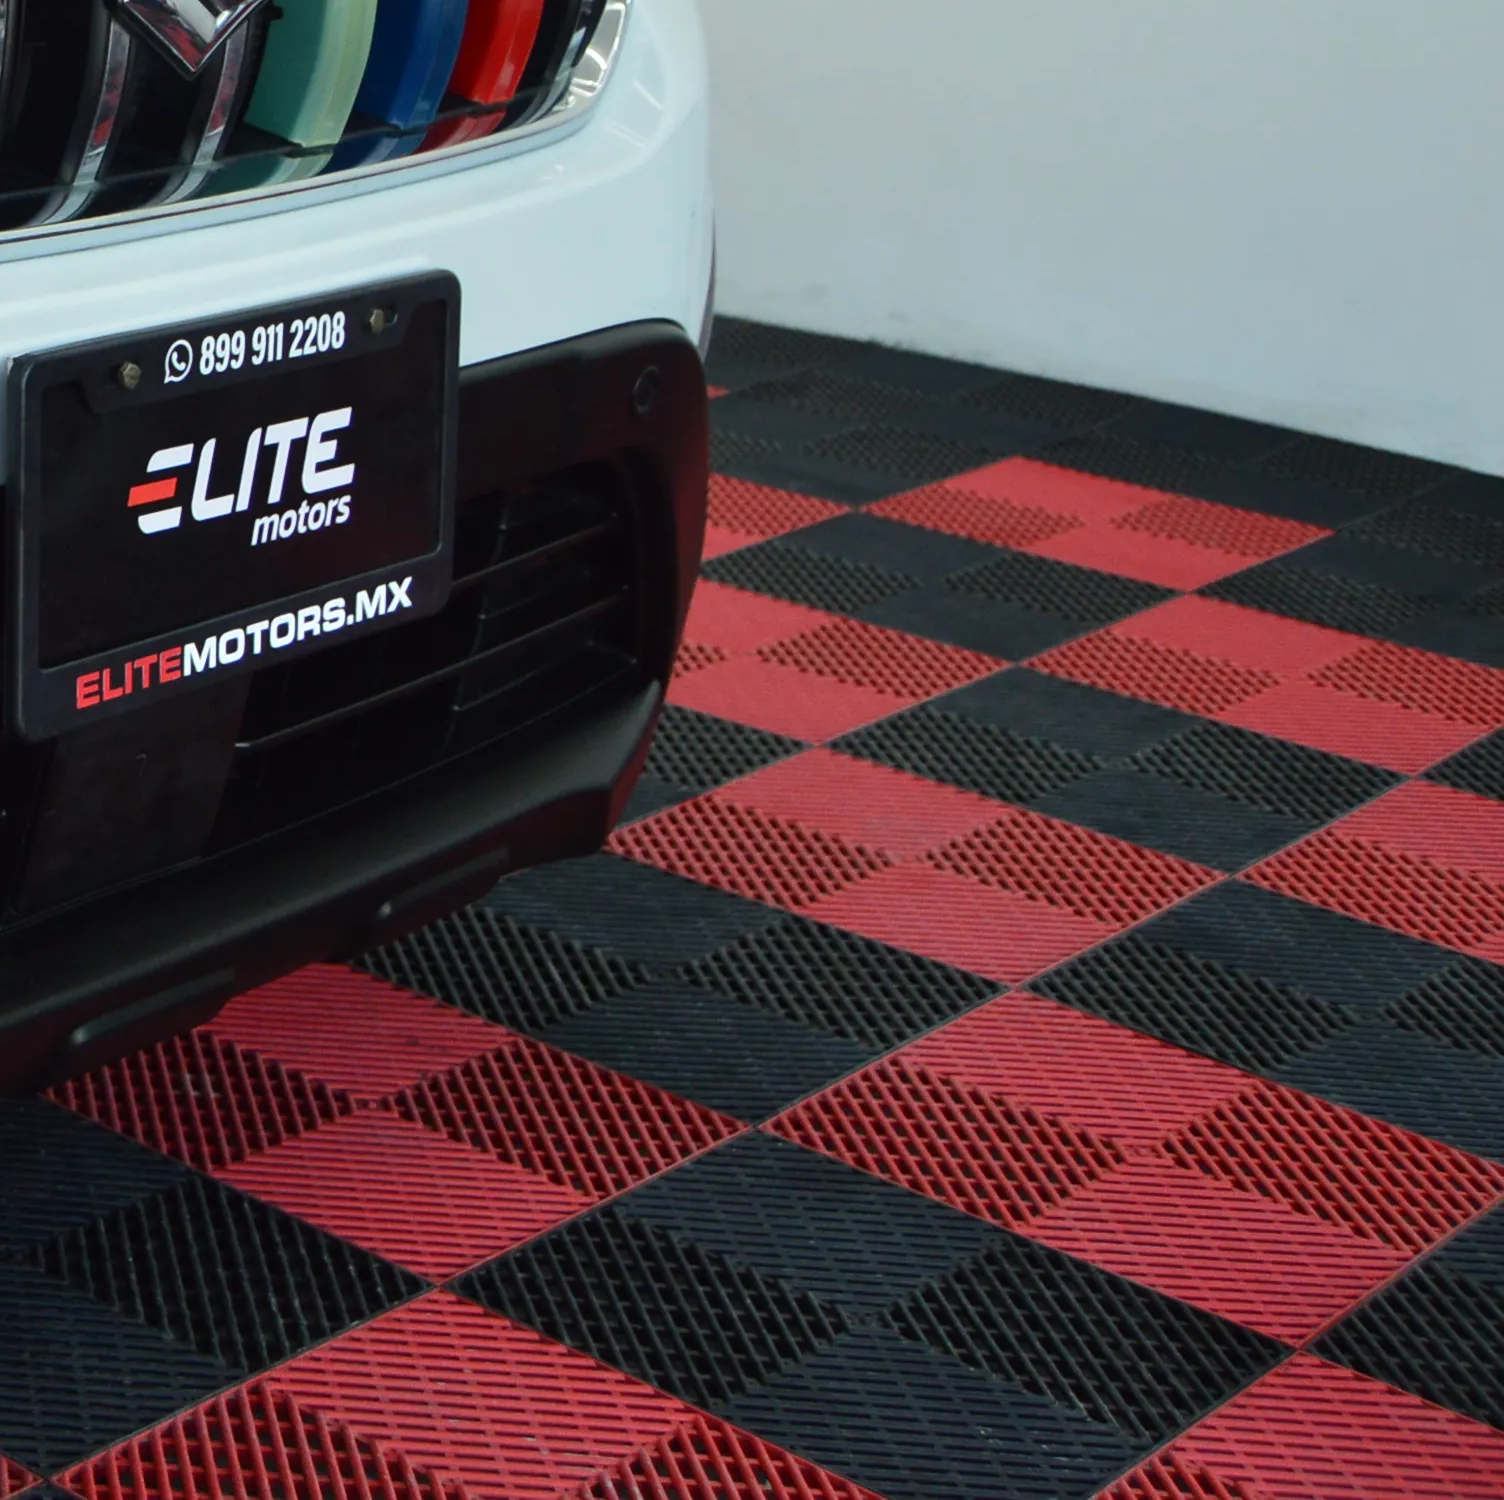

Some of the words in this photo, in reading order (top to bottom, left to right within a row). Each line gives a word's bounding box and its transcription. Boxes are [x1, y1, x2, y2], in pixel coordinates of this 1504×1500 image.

[199, 330, 246, 376] 899
[251, 322, 284, 366] 911
[288, 310, 346, 358] 2208
[127, 406, 355, 535] ELITE
[250, 494, 351, 546] motors
[76, 576, 413, 710] ELITEMOTORS.MX
